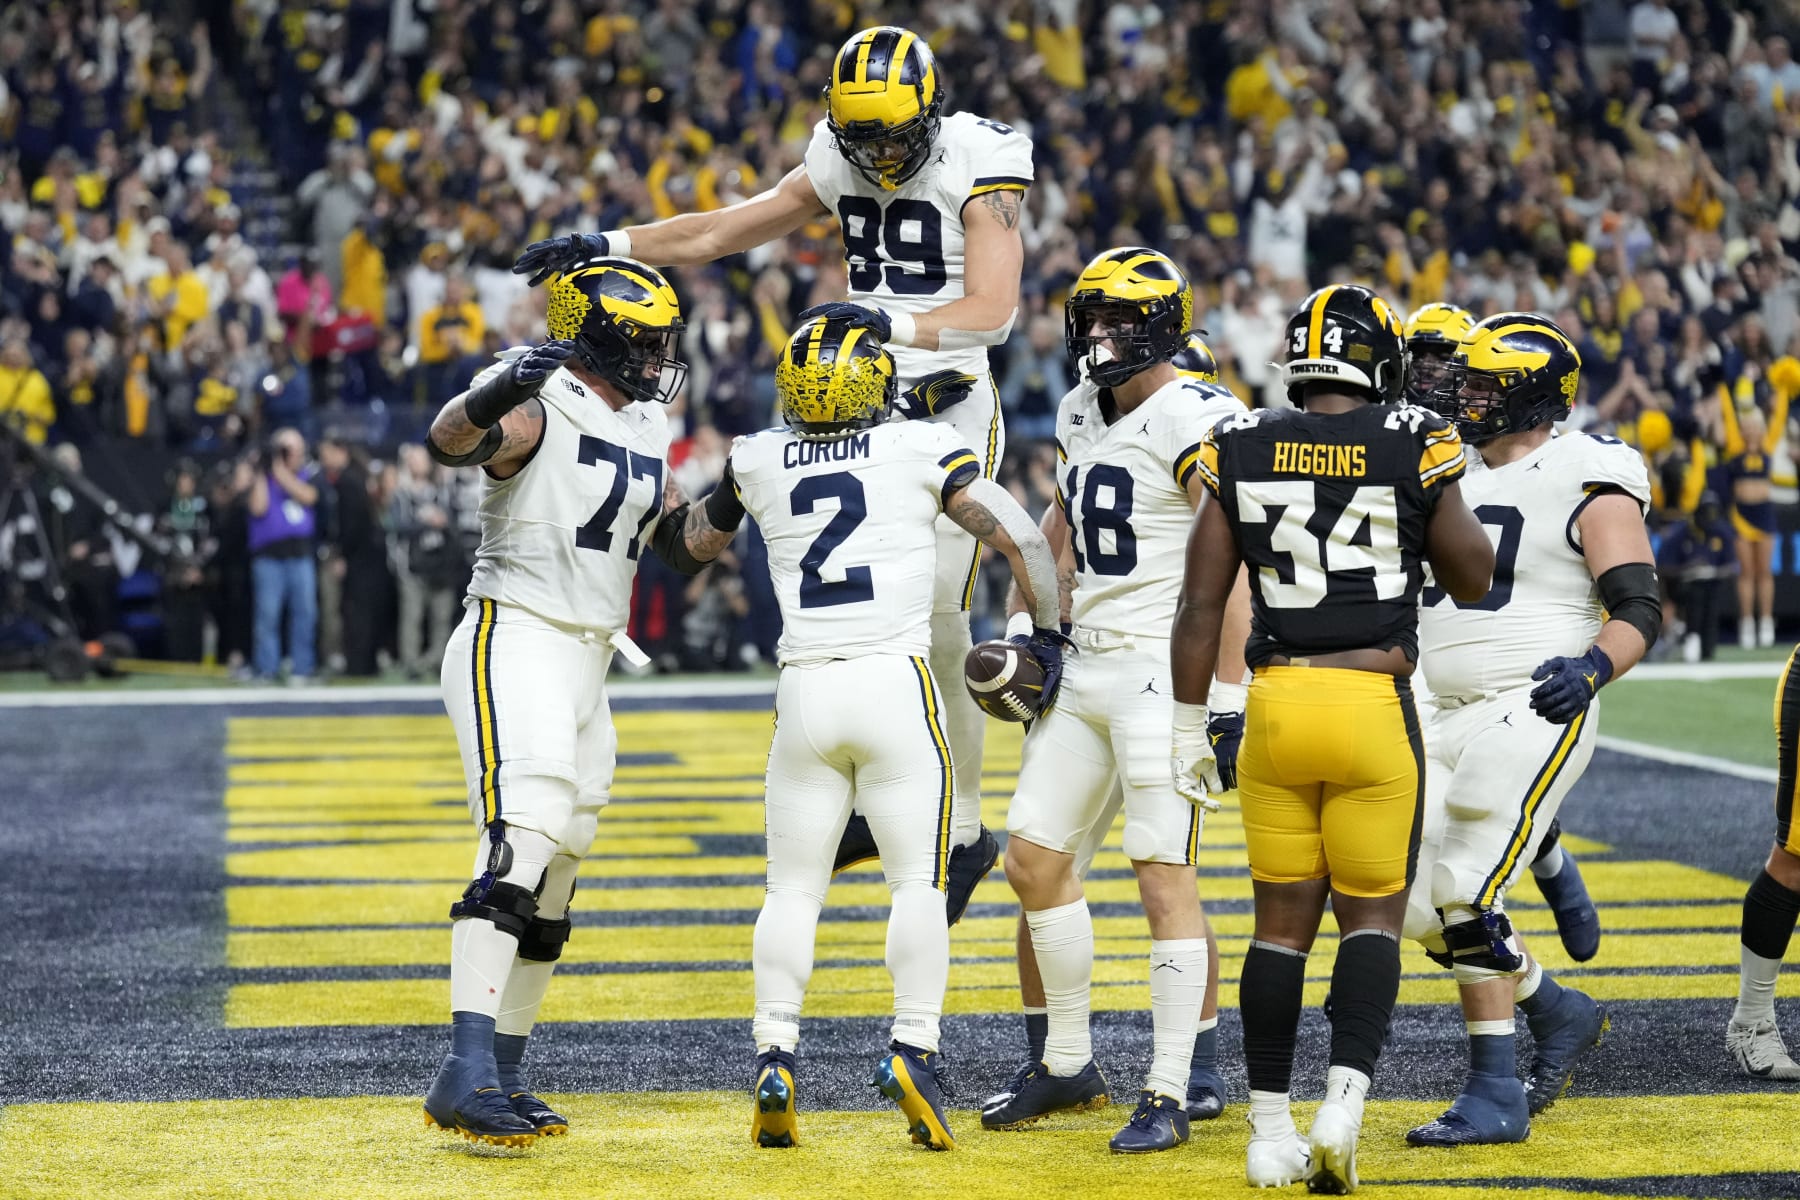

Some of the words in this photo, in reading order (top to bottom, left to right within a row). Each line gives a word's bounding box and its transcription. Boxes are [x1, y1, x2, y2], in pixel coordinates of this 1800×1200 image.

[837, 195, 947, 295] 89
[576, 434, 663, 561] 77
[784, 433, 871, 469] CORUM
[1273, 441, 1367, 477] HIGGINS
[790, 471, 874, 609] 2
[1064, 463, 1138, 576] 18
[1235, 480, 1408, 608] 34
[1421, 504, 1525, 612] 0
